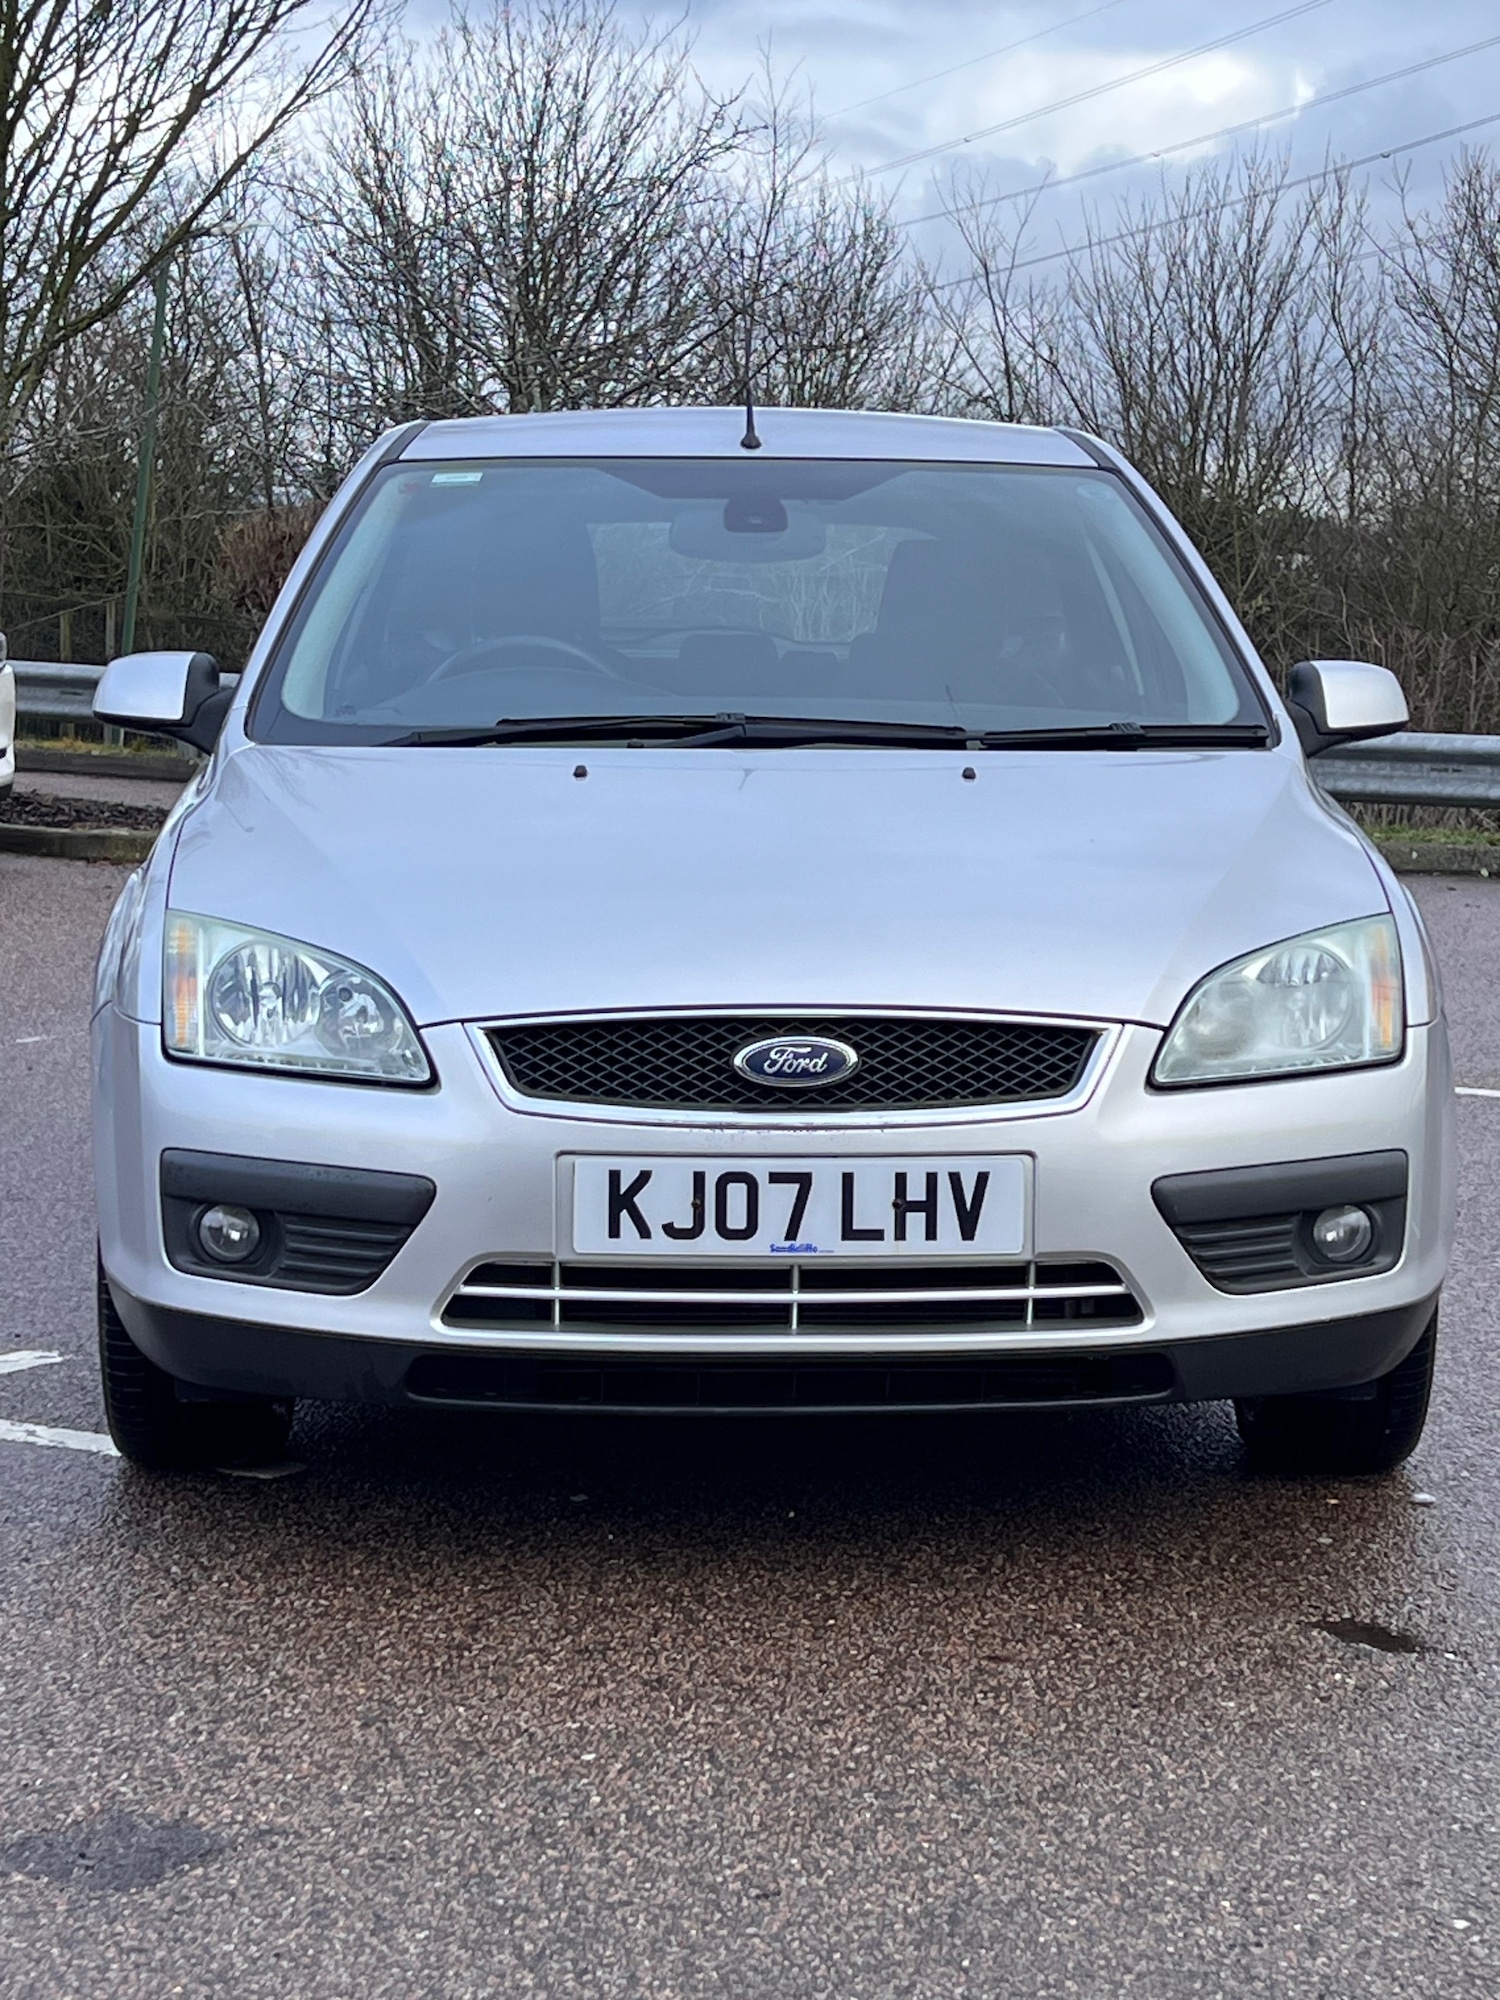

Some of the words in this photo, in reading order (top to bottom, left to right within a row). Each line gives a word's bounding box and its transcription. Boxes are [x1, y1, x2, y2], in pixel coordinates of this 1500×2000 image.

[763, 1046, 828, 1074] Ford
[607, 1169, 813, 1242] KJ07
[841, 1171, 991, 1242] LHV
